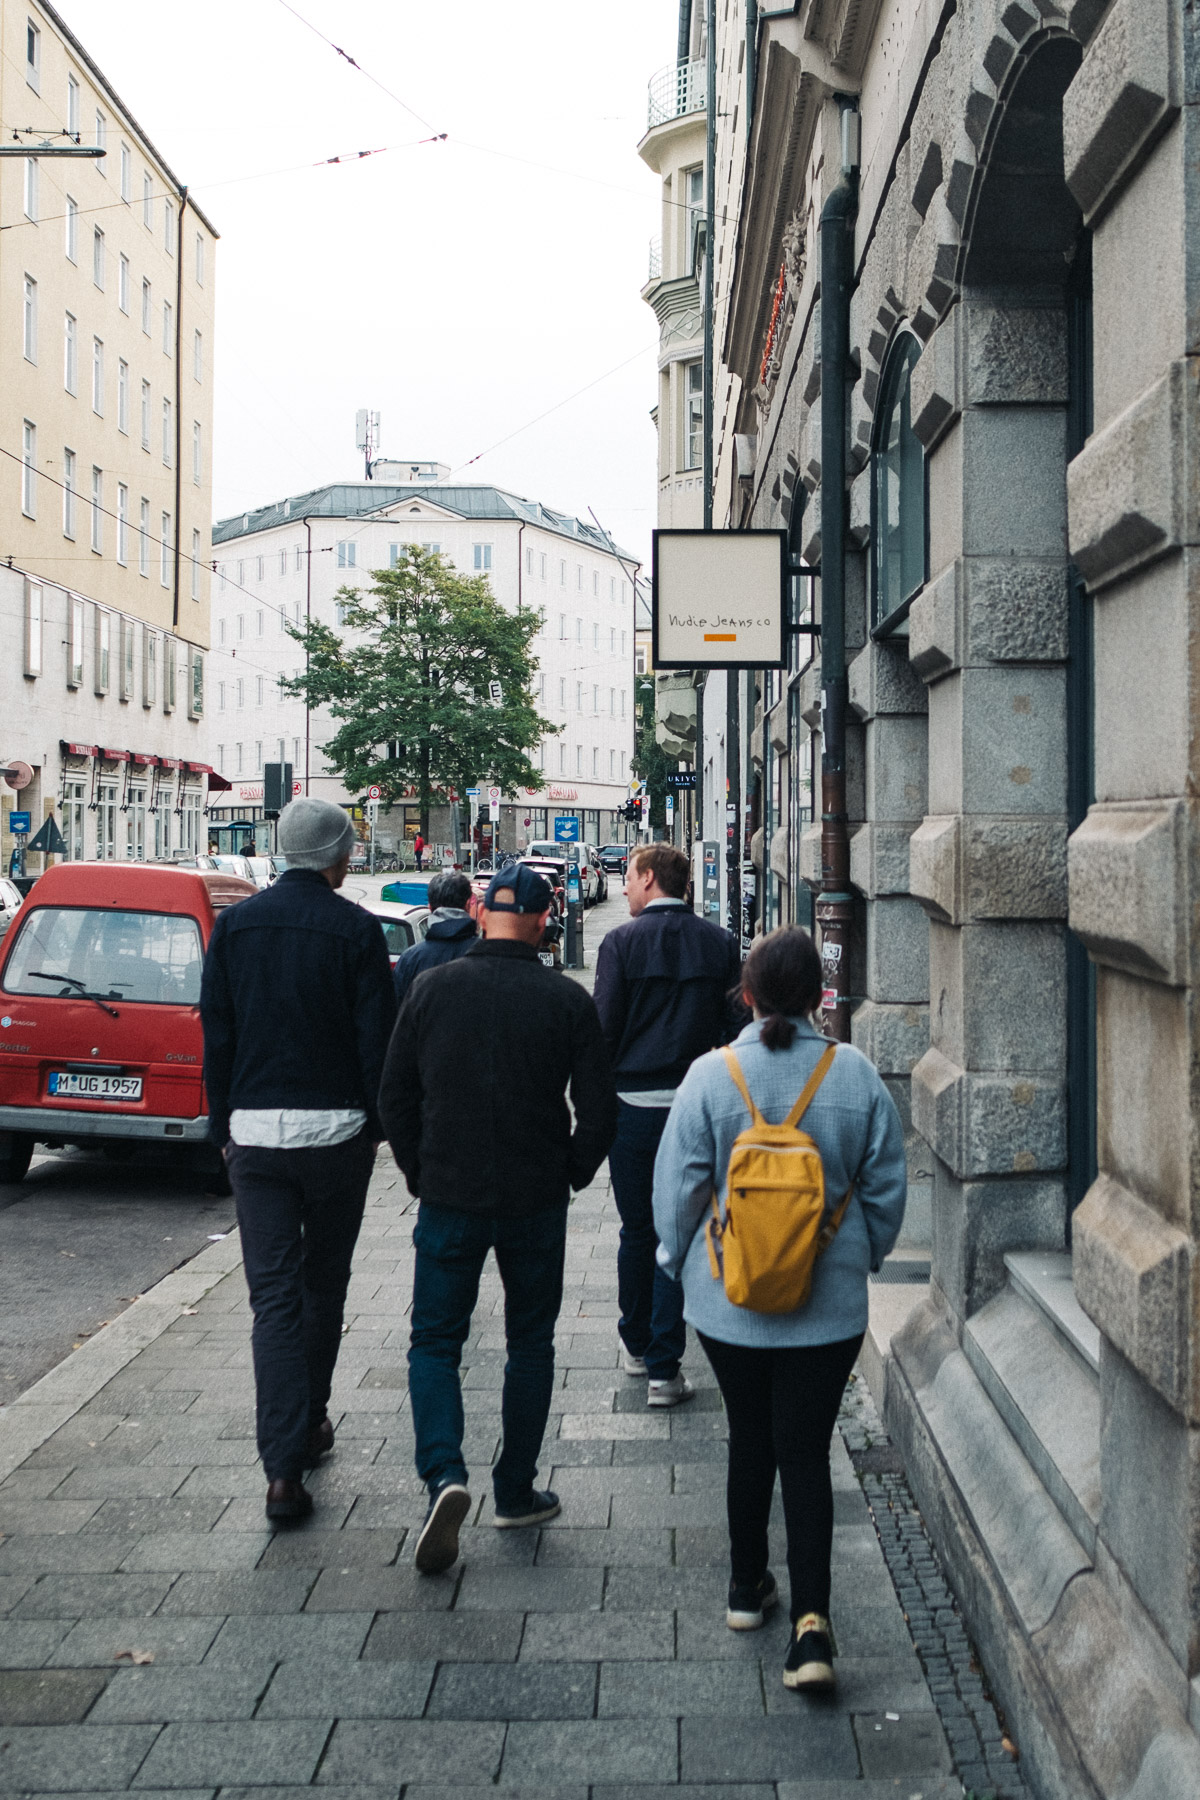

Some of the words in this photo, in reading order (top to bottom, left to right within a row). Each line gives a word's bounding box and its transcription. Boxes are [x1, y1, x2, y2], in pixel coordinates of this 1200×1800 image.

[490, 684, 500, 698] E
[568, 864, 575, 874] P
[166, 1053, 197, 1062] G-Van
[58, 1076, 68, 1090] M
[78, 1076, 98, 1092] UG
[102, 1078, 140, 1094] 1957
